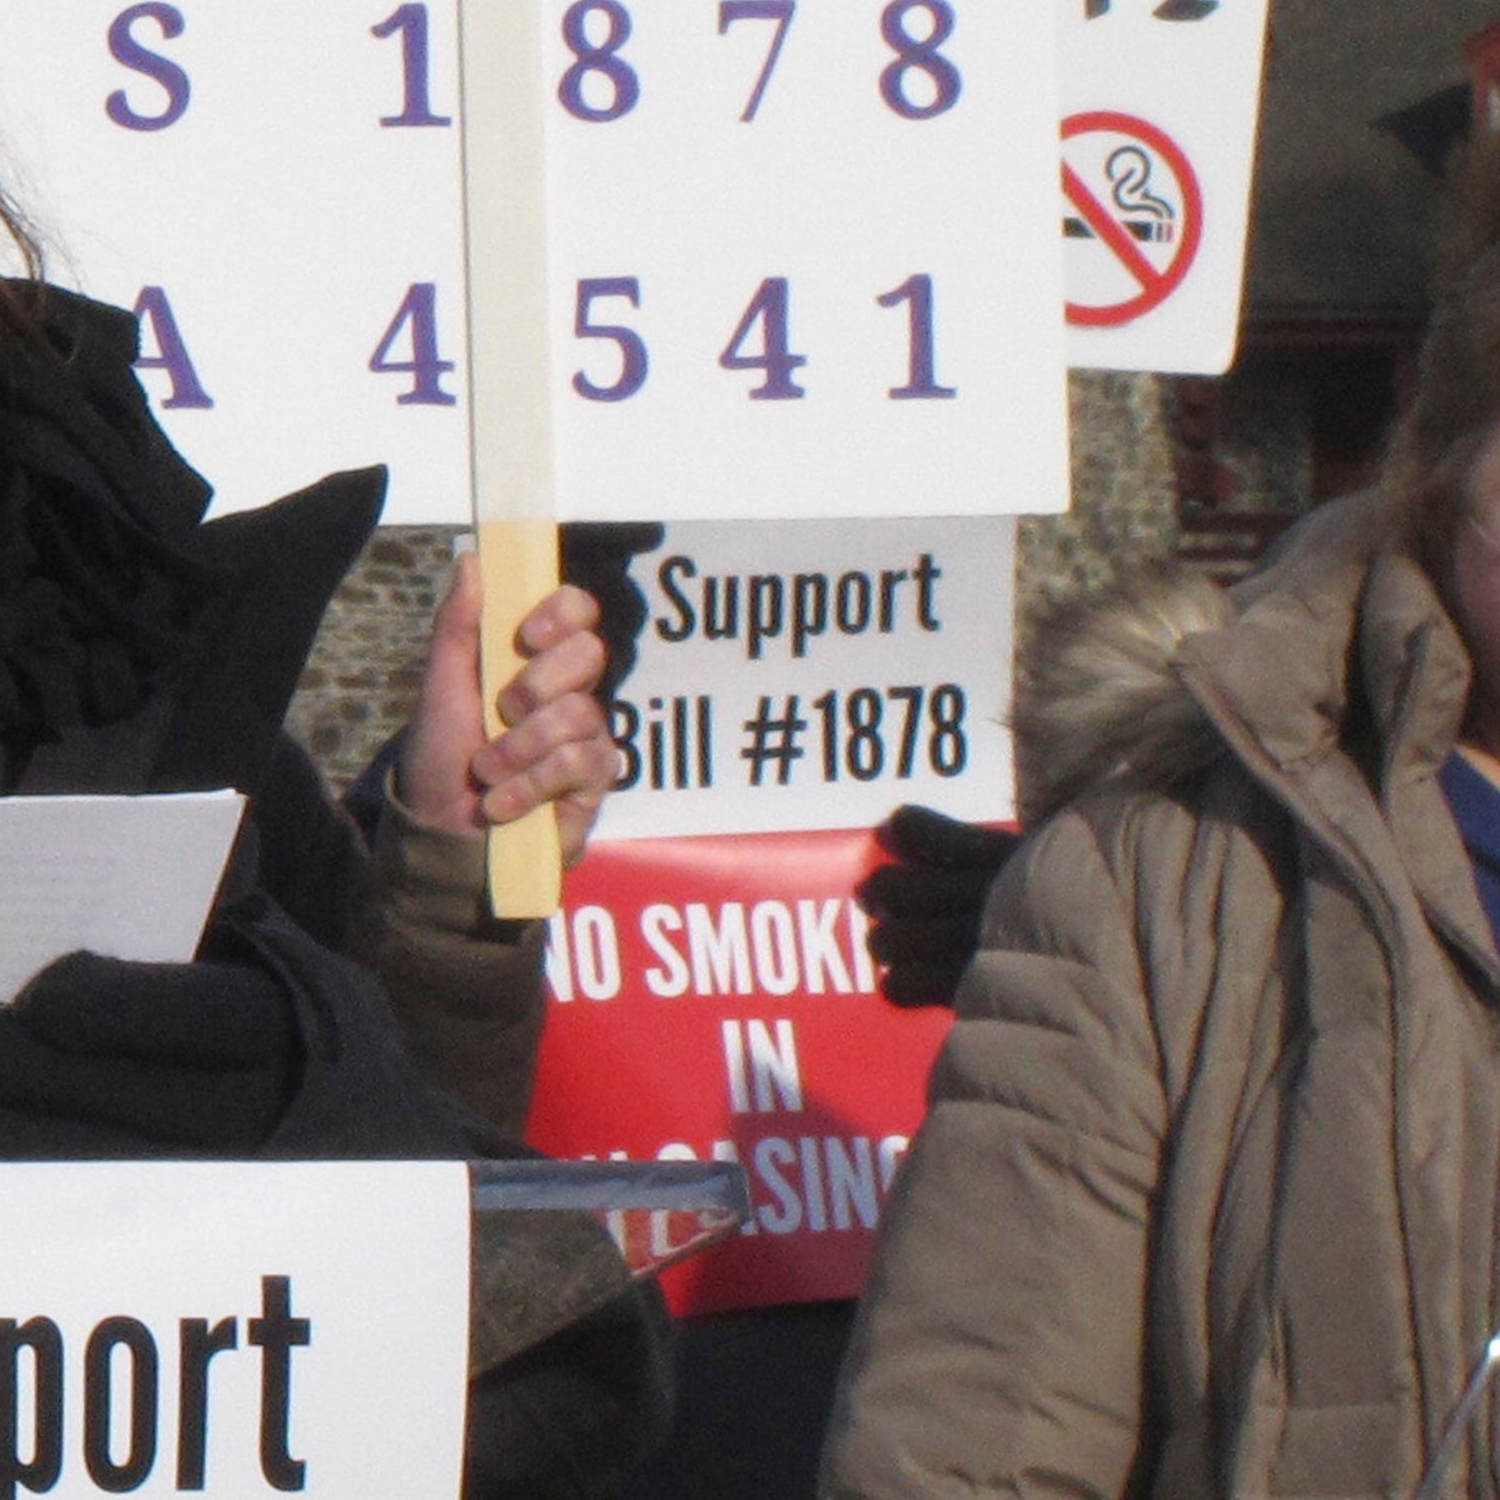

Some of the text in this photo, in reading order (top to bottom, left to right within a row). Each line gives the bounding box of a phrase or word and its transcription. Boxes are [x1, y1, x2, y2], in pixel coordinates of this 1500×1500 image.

[104, 2, 191, 131] S
[128, 274, 957, 410] A 4541
[654, 554, 942, 660] Support
[739, 682, 968, 788] #1878
[721, 1017, 804, 1114] IN
